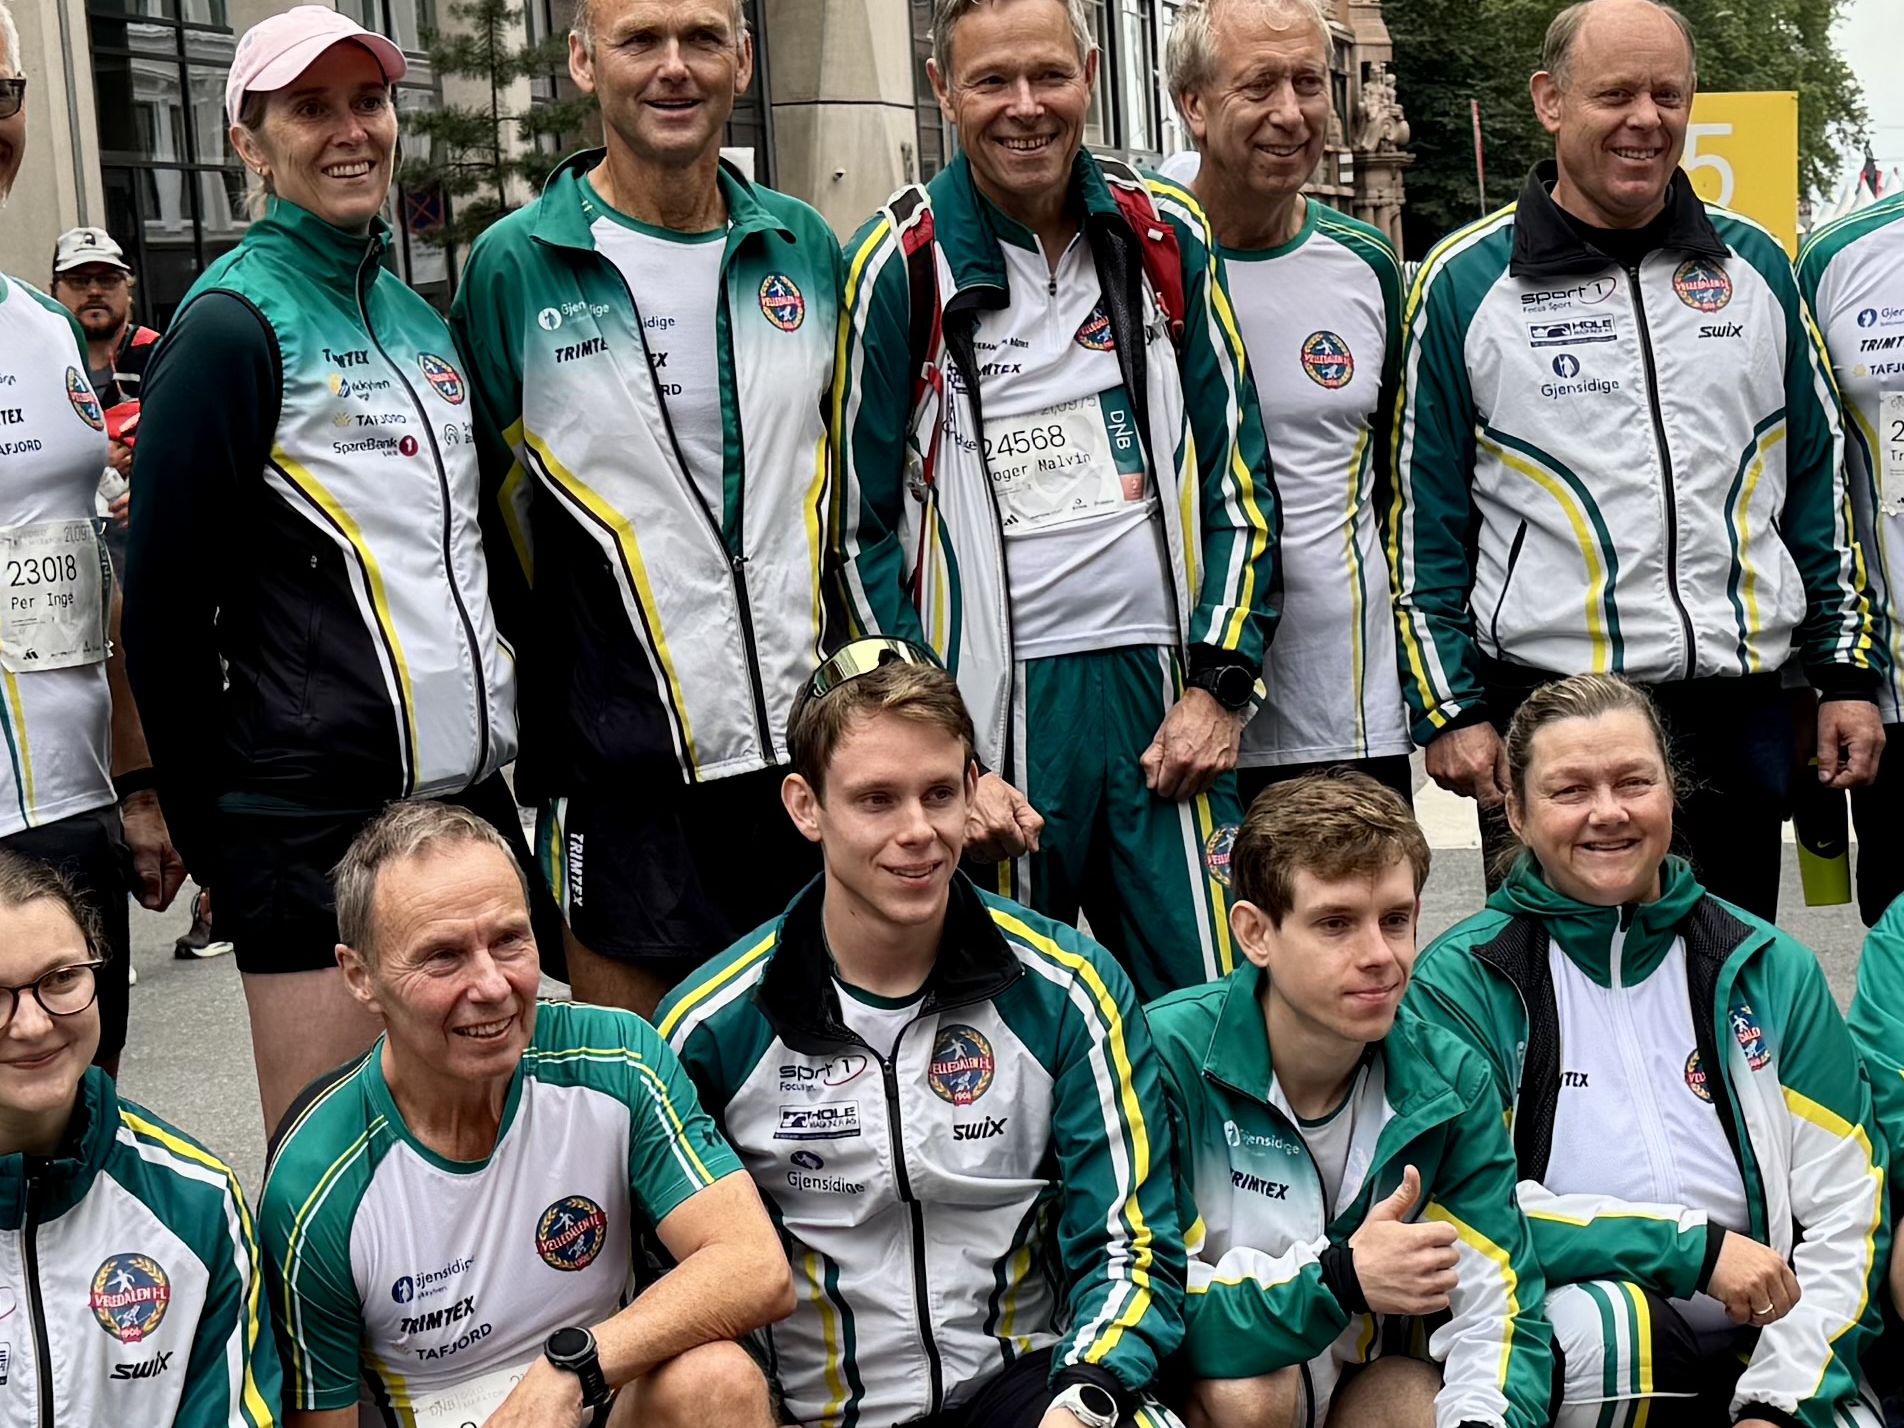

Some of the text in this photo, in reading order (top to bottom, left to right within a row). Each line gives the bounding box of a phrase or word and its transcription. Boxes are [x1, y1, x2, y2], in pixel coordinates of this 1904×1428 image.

[1520, 285, 1587, 305] sport
[1572, 319, 1611, 330] HOLE
[1541, 378, 1620, 400] Gjensidige
[1109, 409, 1134, 450] DNB
[992, 451, 1092, 483] oger Malvin
[7, 554, 77, 587] 23018
[11, 592, 75, 611] Per Inge
[953, 1115, 1008, 1141] swix
[1230, 1168, 1290, 1201] RIMTEX
[400, 1295, 476, 1335] TRIMTEX
[416, 1323, 493, 1361] TAFJORD
[110, 1350, 174, 1380] swix
